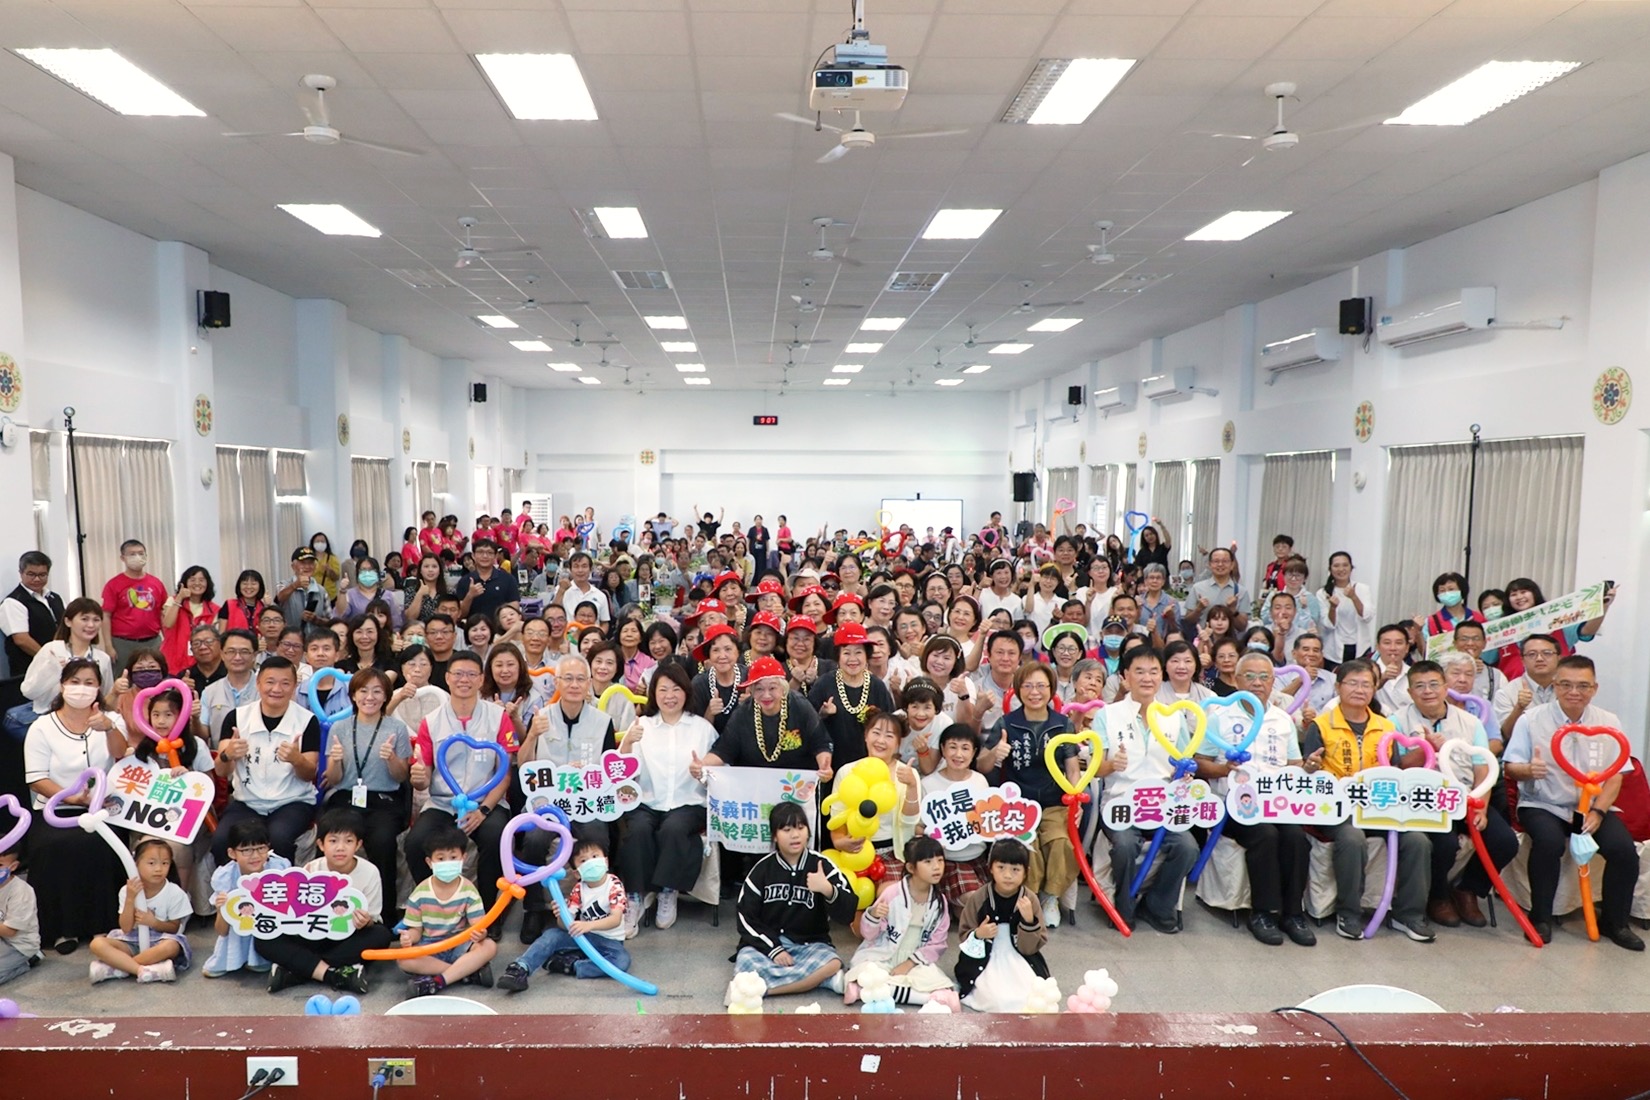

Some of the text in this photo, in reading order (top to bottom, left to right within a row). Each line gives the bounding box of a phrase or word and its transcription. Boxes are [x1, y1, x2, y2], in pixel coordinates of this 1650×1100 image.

[115, 764, 188, 805] 樂齡
[524, 760, 627, 794] 祖孫傳愛
[1256, 773, 1334, 795] 世代共融
[124, 798, 206, 839] NO.1
[552, 795, 616, 816] 樂永續
[926, 788, 974, 824] 你是
[942, 809, 1036, 845] 我的花朵
[261, 881, 326, 906] 幸福
[254, 912, 329, 934] 每一天
